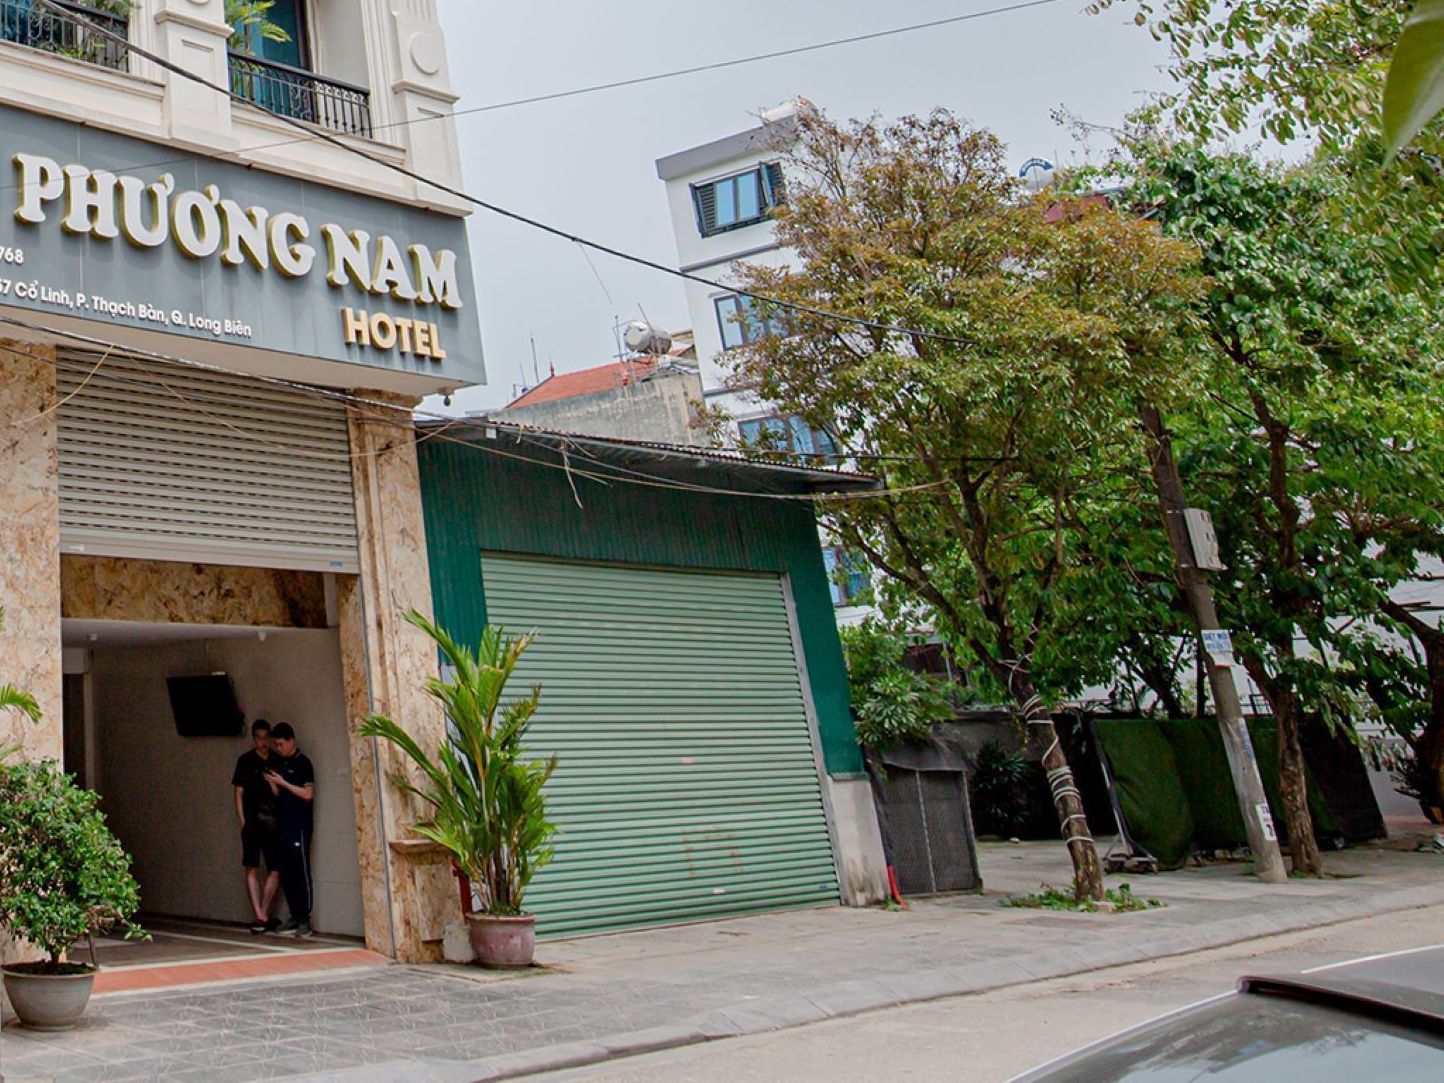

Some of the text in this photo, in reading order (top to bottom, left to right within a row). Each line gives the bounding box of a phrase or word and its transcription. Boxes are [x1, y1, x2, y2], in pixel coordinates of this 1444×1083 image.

[13, 153, 463, 308] PHƯƠNG NAM
[15, 280, 38, 300] Cổ
[41, 286, 73, 310] Linh,
[76, 293, 90, 309] P.
[92, 295, 135, 317] Thạch
[189, 313, 221, 335] Long
[224, 319, 252, 337] Biên
[341, 307, 446, 360] HOTEL
